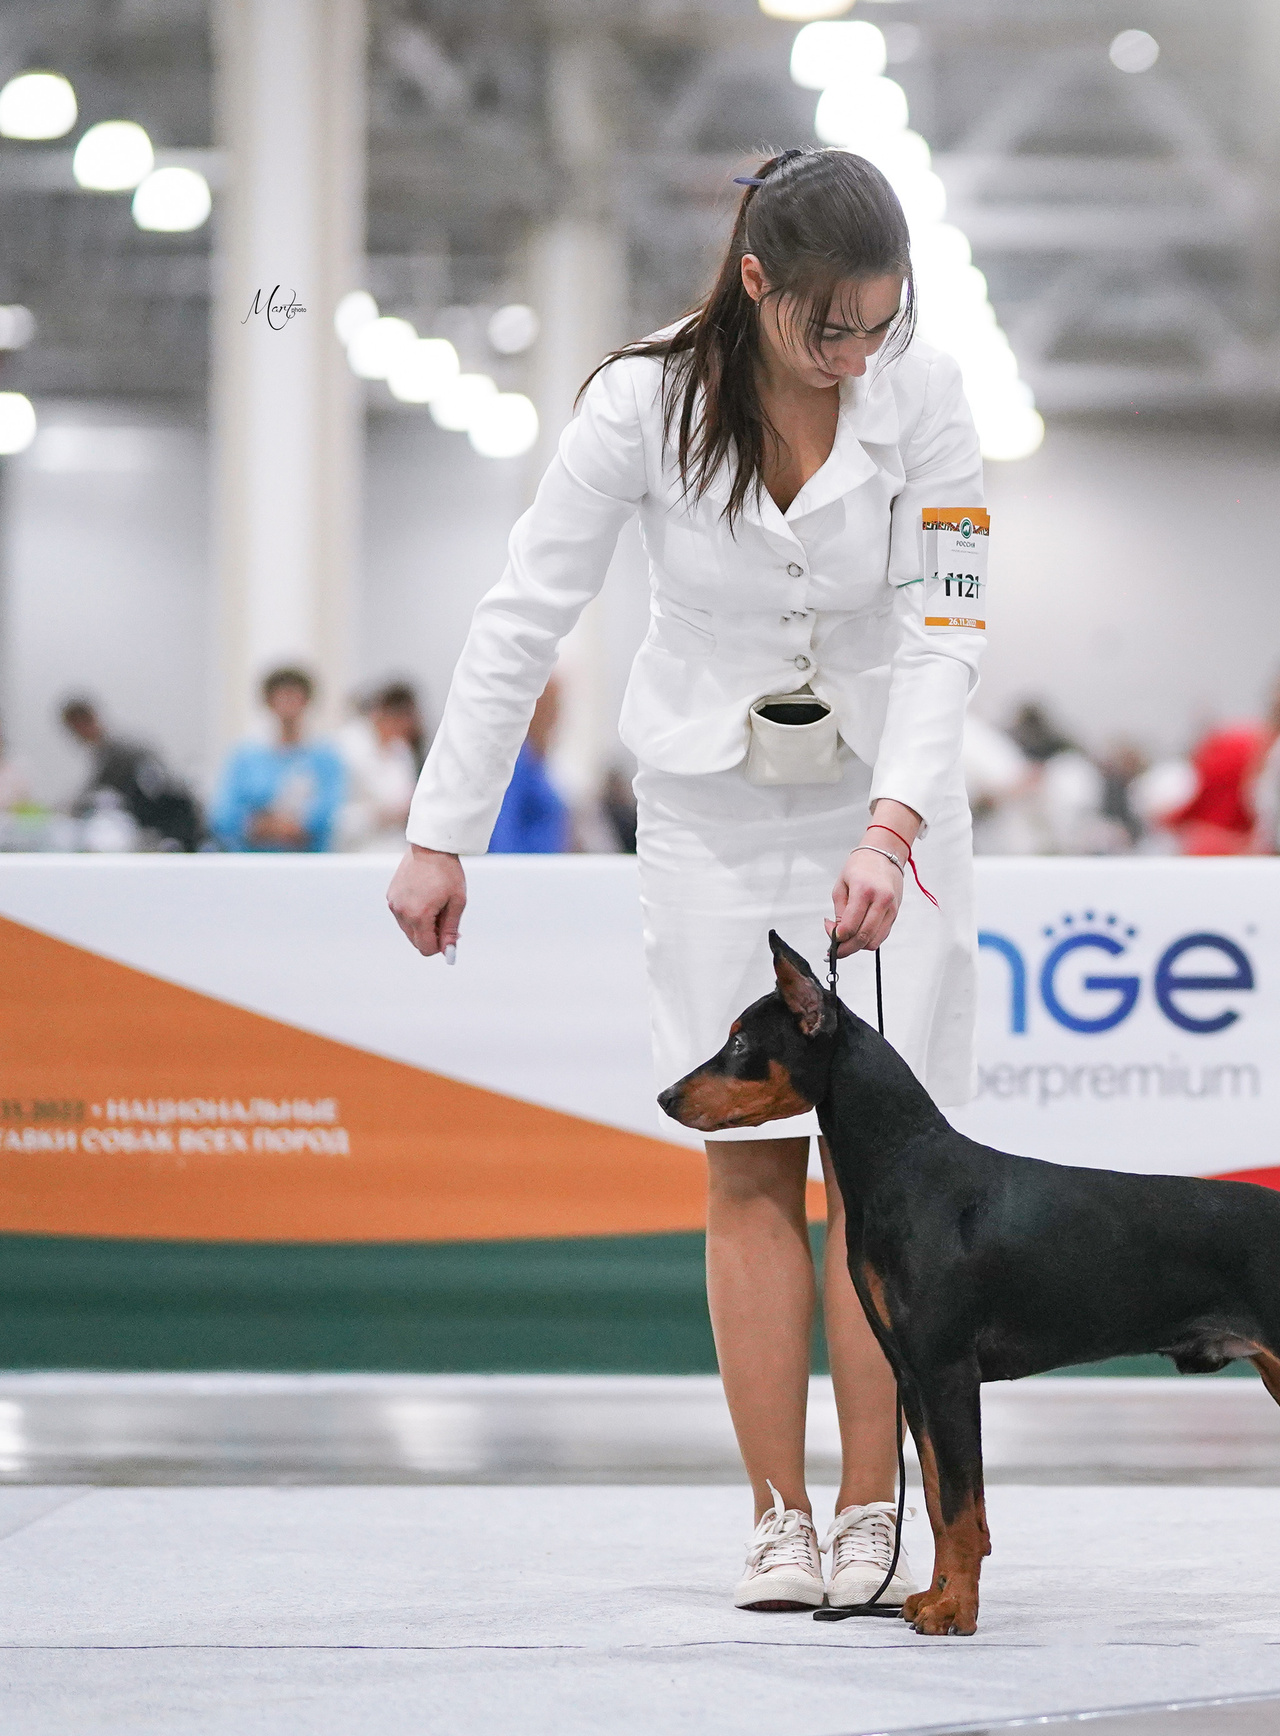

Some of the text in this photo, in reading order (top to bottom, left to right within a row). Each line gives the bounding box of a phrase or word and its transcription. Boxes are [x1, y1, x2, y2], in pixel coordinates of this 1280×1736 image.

[945, 572, 979, 599] 1121
[106, 1098, 338, 1125] НАЦИОНАЛЬНЫЕ
[81, 1126, 173, 1153] СОБАК
[177, 1126, 249, 1153] ВСЕХ
[252, 1126, 349, 1154] ПОРОД
